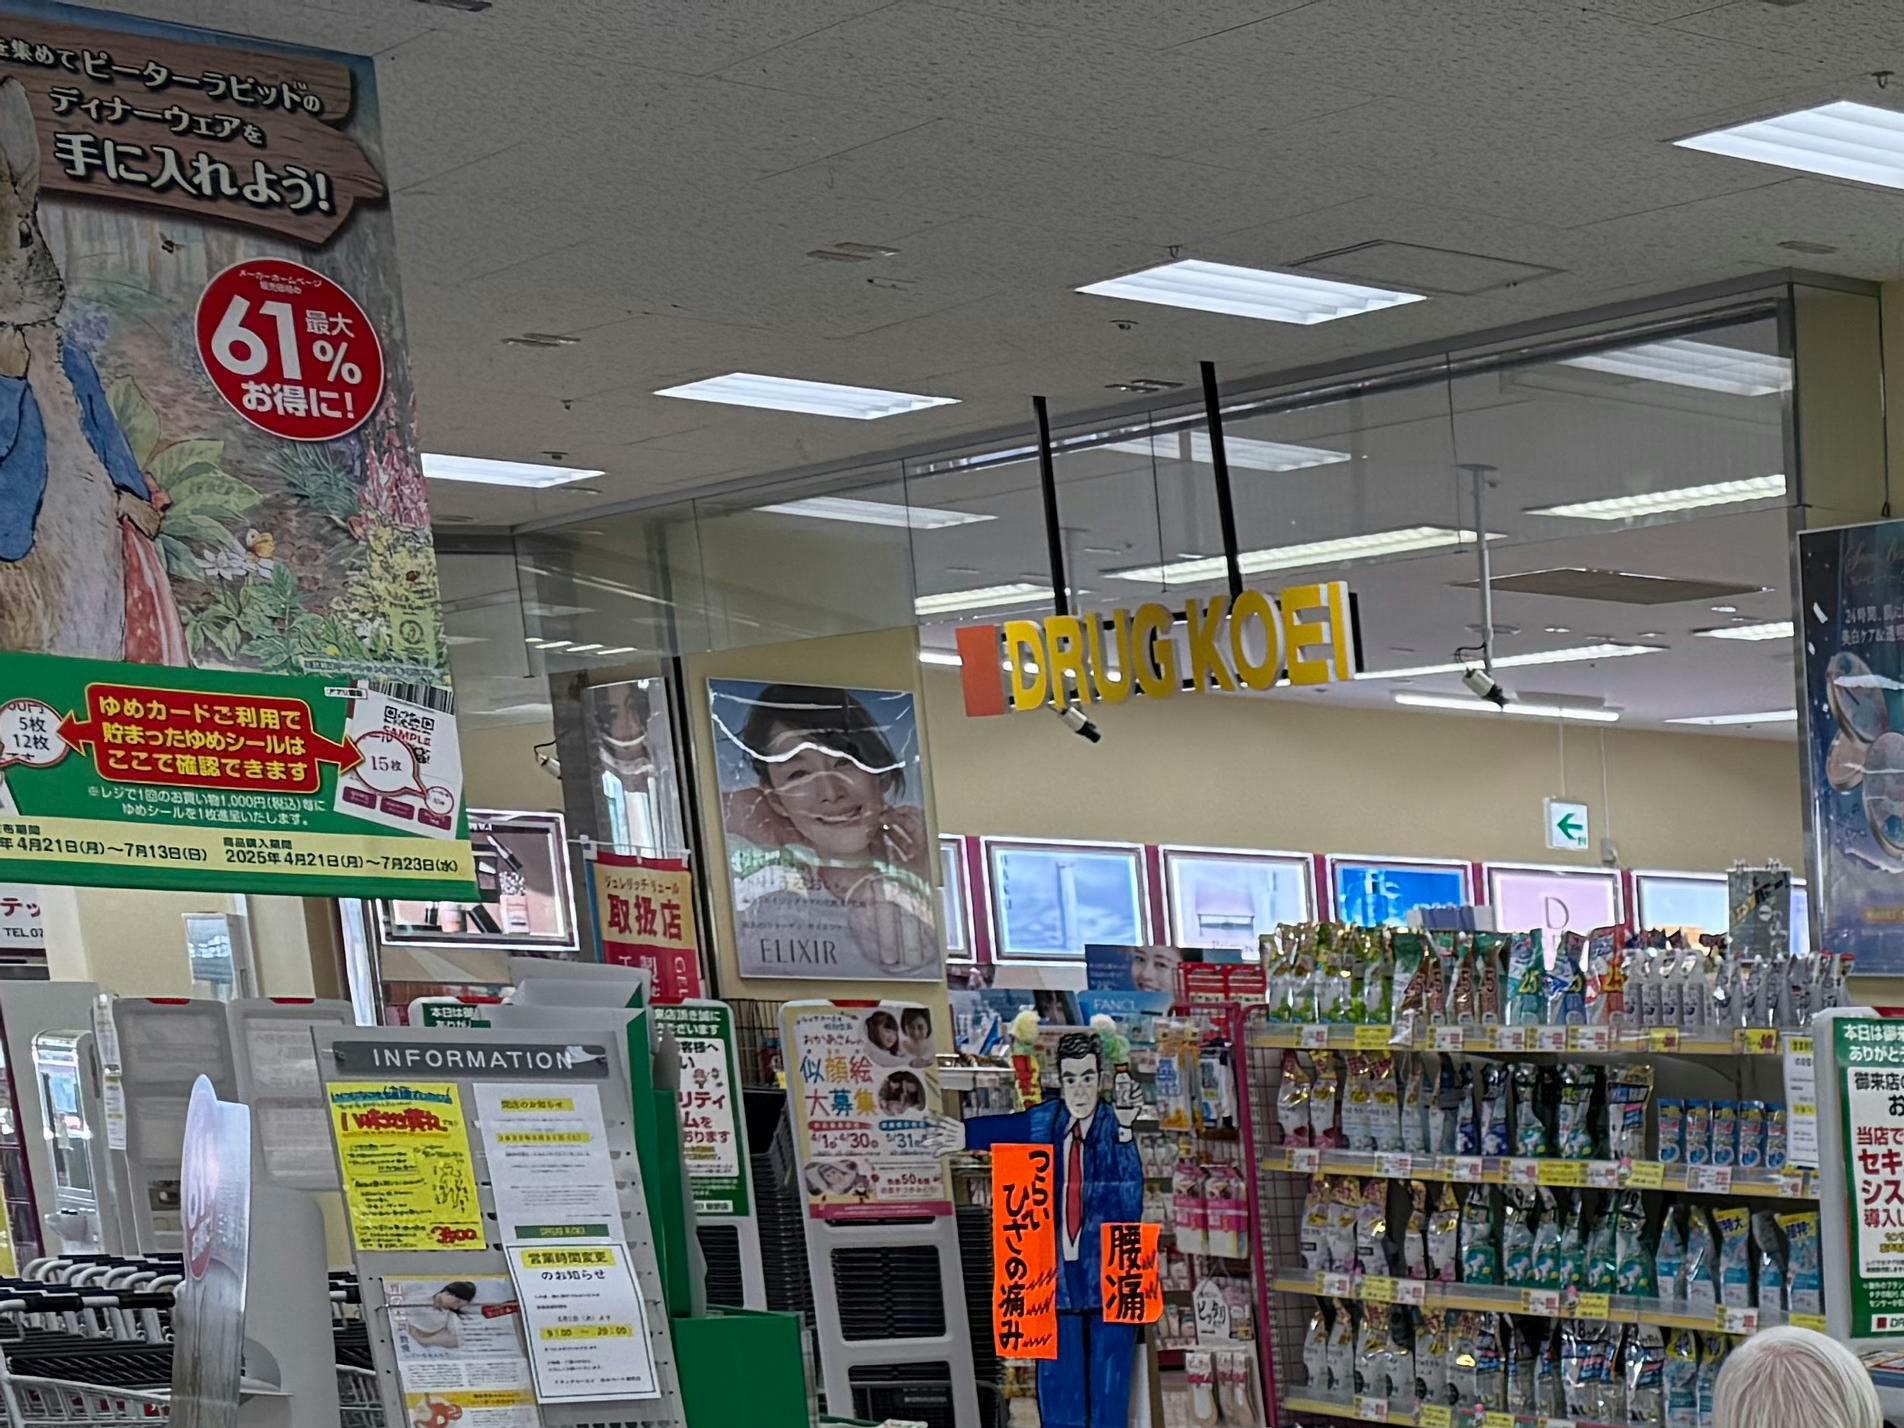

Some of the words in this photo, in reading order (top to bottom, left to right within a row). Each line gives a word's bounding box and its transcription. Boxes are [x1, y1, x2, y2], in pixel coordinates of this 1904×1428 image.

[49, 85, 265, 146] ディナーウェアを
[54, 131, 337, 213] 手に入れよう!
[211, 294, 303, 380] 61
[305, 309, 356, 338] 最大
[241, 380, 355, 420] お得に!
[1006, 604, 1178, 712] DRUG
[1187, 581, 1354, 696] KOEI
[18, 716, 47, 733] 5枚
[98, 695, 302, 729] ゆめカードご利用で
[12, 733, 51, 751] 12枚
[101, 721, 307, 757] 貯まったゆめシールは
[106, 749, 309, 783] ここで確認できます
[607, 893, 683, 942] 取扱店
[760, 938, 839, 965] ELIXIR
[373, 1048, 572, 1070] INFORMATION
[799, 1063, 876, 1086] 似顔絵
[805, 1088, 878, 1117] 大募集
[1026, 1150, 1052, 1233] つらい
[541, 1269, 607, 1281] のお知らせ
[1105, 1224, 1147, 1322] 腰痛
